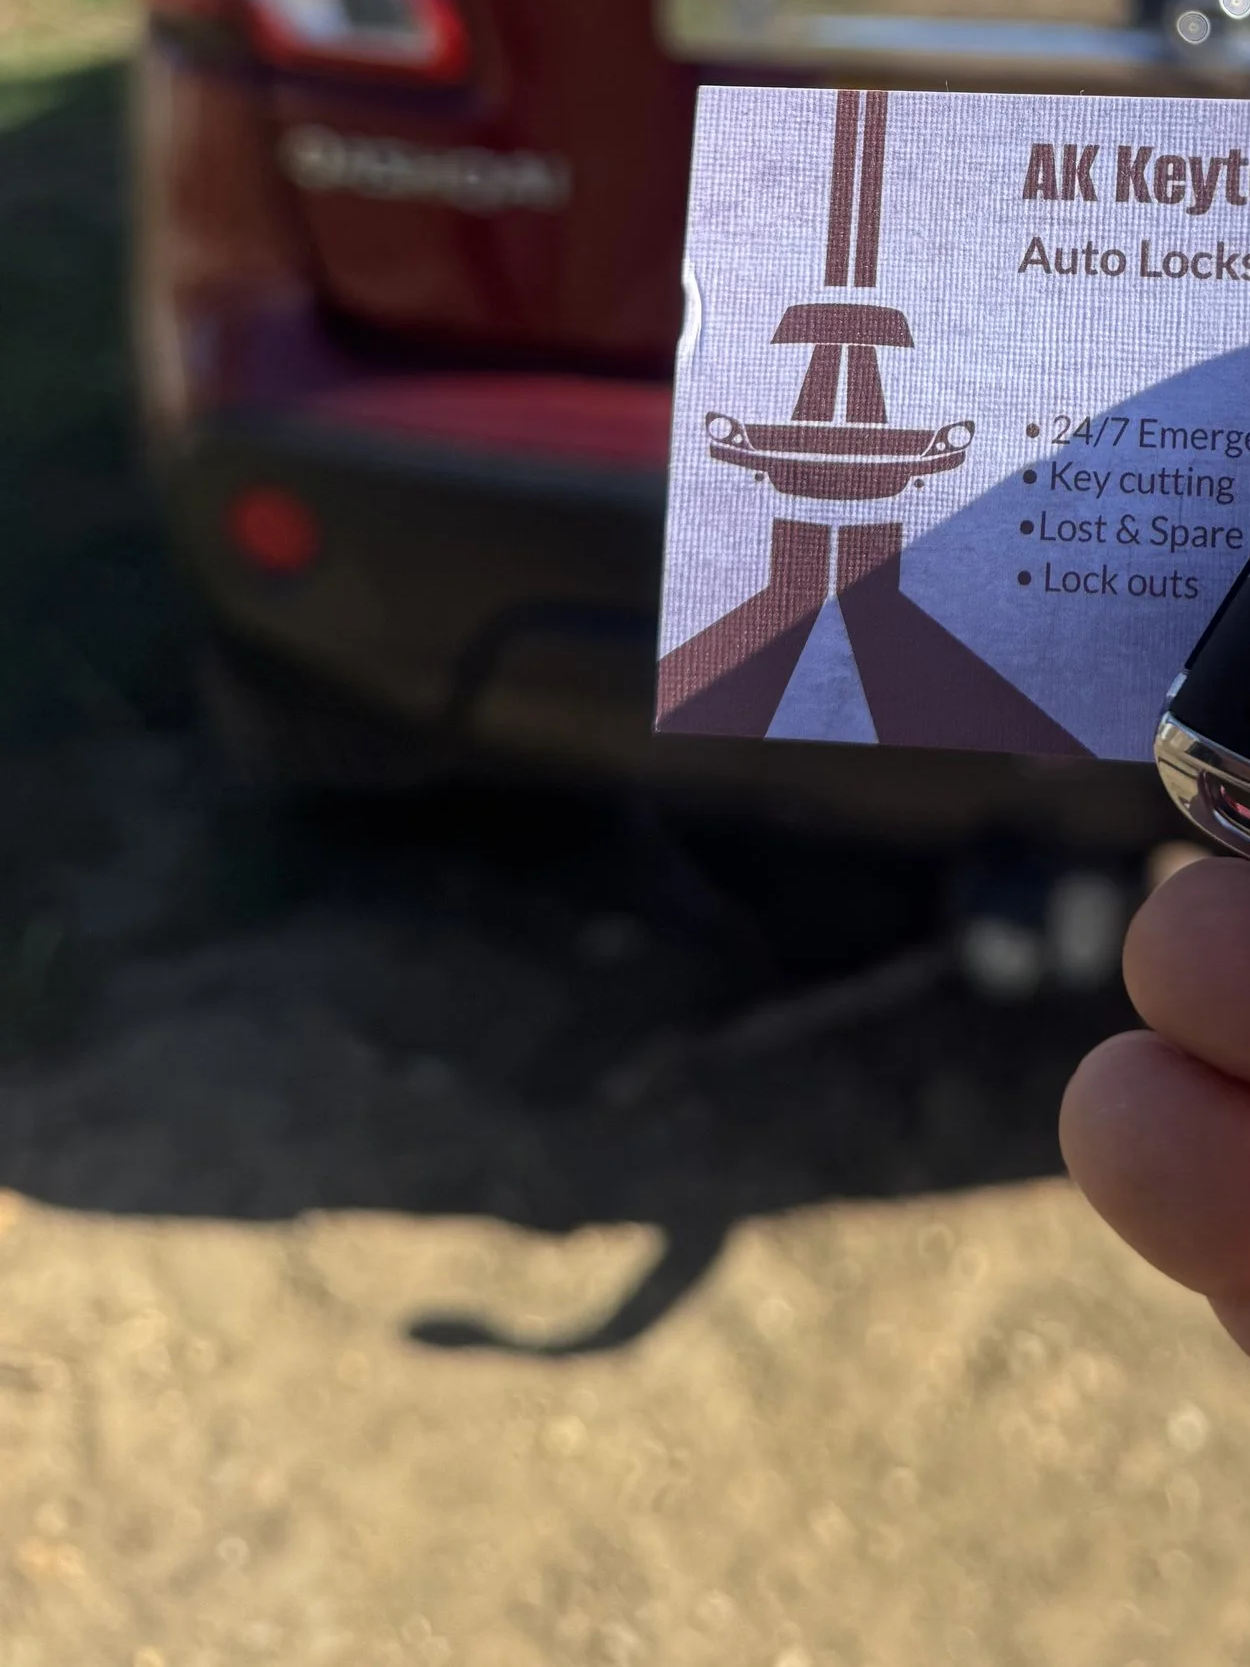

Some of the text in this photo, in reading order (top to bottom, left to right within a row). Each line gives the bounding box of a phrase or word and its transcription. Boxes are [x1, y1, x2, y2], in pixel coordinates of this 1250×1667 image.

[1021, 142, 1100, 203] AK
[1017, 236, 1127, 276] Auto
[1051, 414, 1130, 448] 24/7
[1050, 460, 1236, 505] Key cutting
[1039, 510, 1108, 543] Lost
[1115, 513, 1141, 545] &
[1150, 515, 1244, 554] Spare
[1044, 562, 1200, 600] Lock outs
